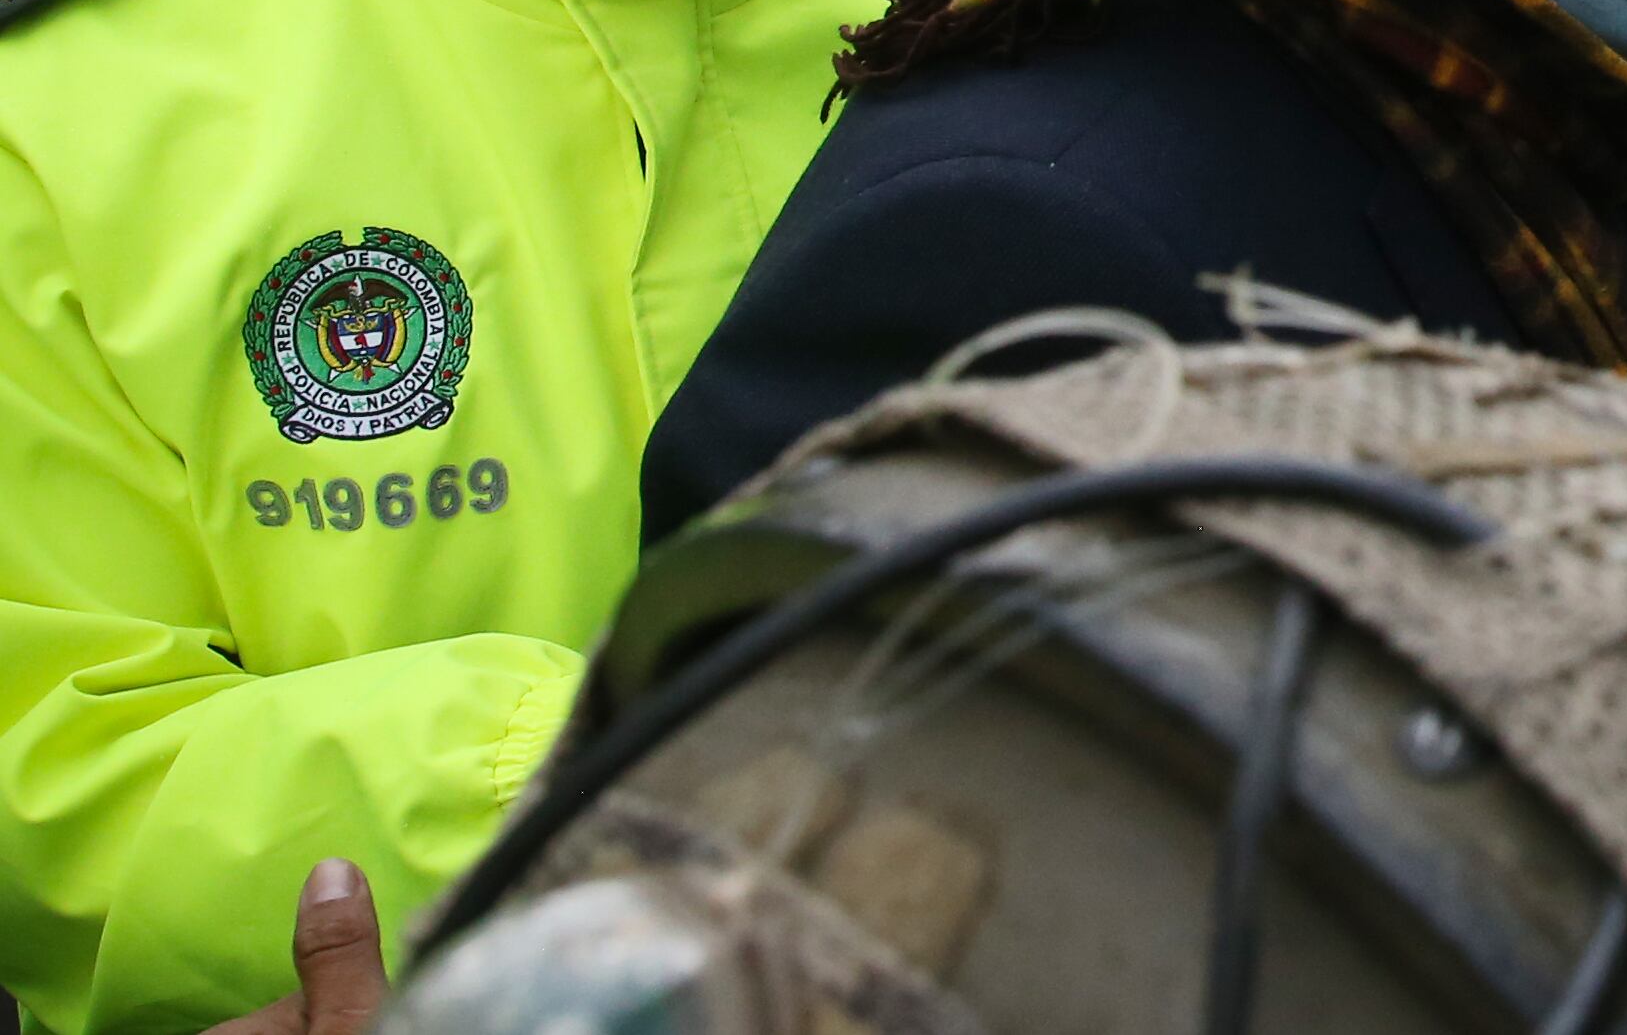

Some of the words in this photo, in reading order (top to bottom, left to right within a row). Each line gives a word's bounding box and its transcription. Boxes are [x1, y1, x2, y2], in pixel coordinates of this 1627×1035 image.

[343, 252, 369, 267] DE
[386, 257, 444, 336] COLOMBIA
[286, 364, 351, 413] POLICÍA
[366, 351, 438, 409] NACIONAL
[302, 408, 346, 433] DIOS
[352, 419, 364, 435] Y
[369, 394, 435, 433] PATRIA
[245, 457, 509, 532] 919669
